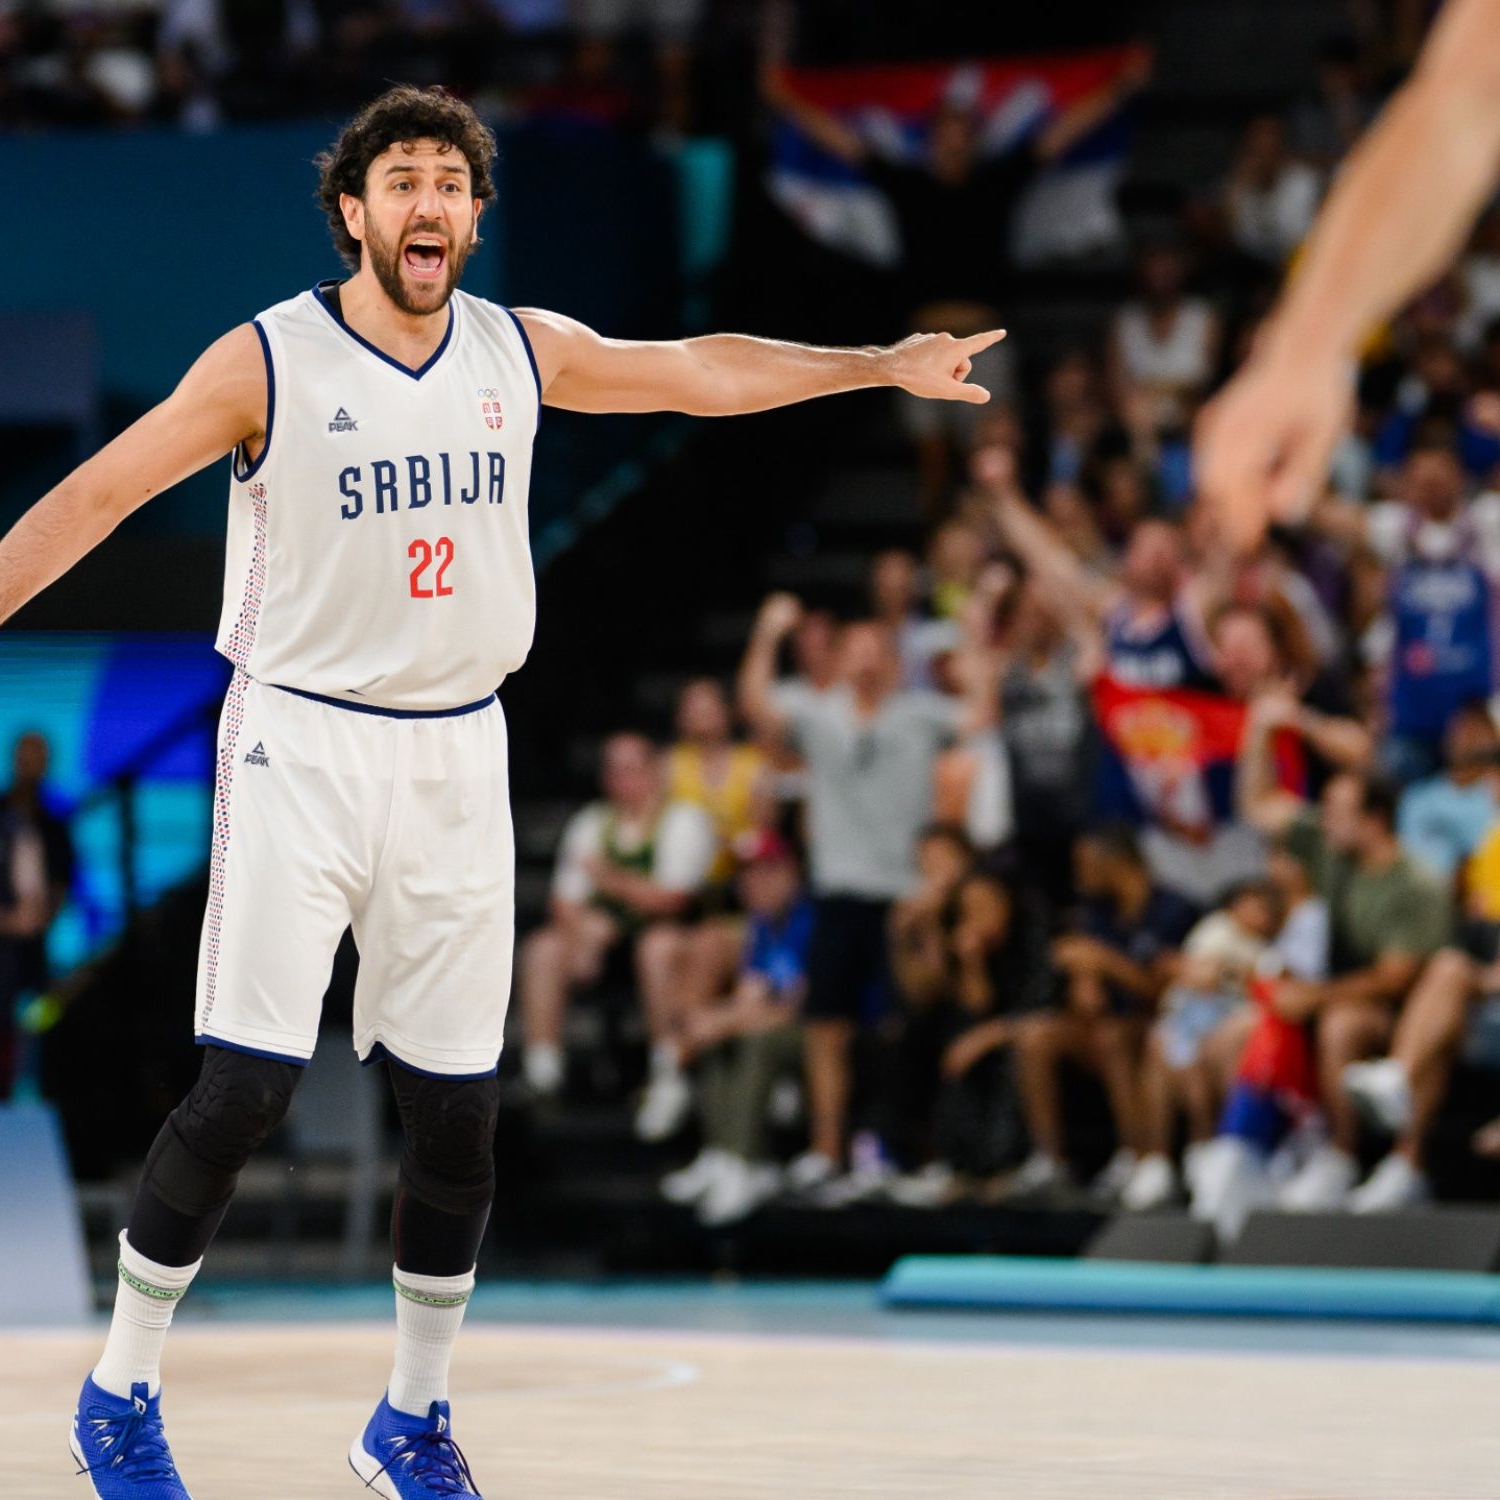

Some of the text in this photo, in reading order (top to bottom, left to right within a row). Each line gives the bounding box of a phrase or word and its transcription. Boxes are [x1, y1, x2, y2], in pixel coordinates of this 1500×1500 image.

[328, 420, 358, 433] PEAK
[338, 451, 506, 520] SRBIJA
[407, 536, 454, 598] 22
